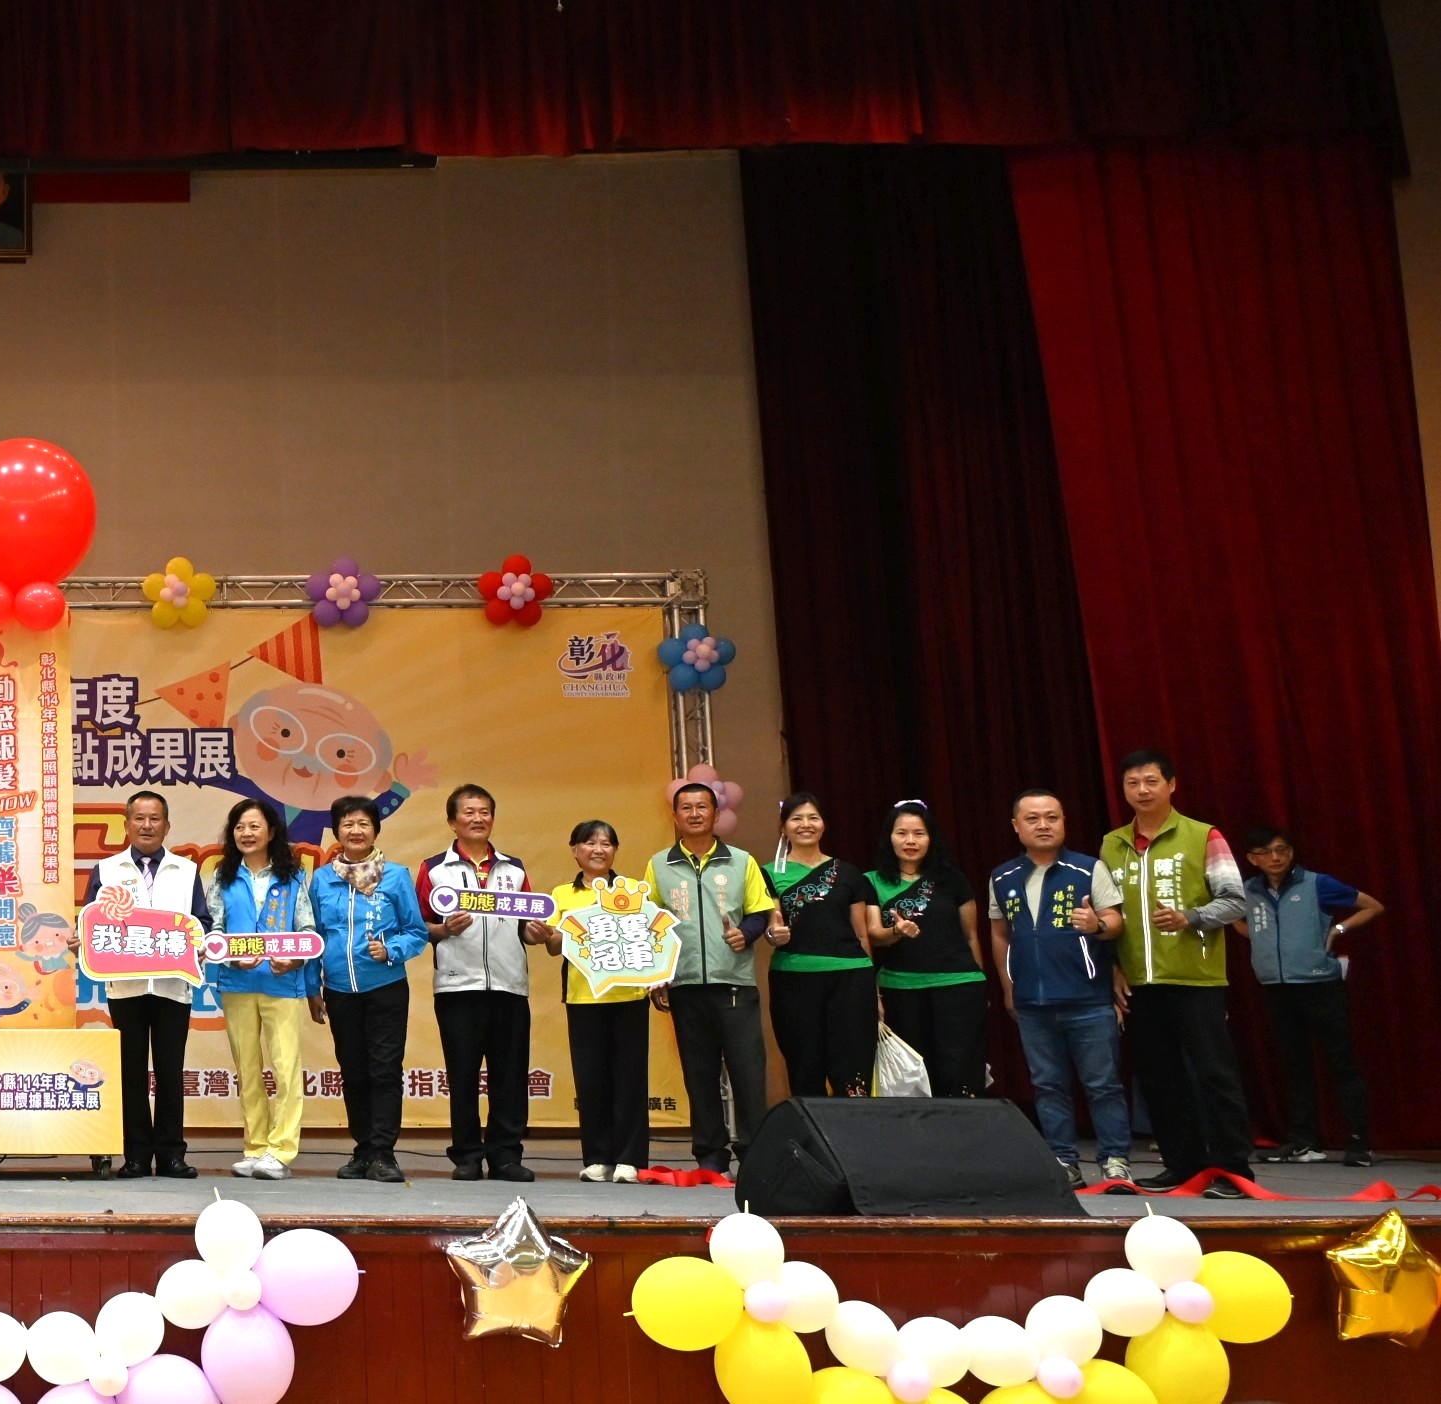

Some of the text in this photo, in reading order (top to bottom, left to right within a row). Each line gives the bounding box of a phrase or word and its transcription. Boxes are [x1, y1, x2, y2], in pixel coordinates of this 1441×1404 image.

[567, 634, 631, 671] 彰化
[563, 683, 628, 691] CHANGHUA
[39, 652, 60, 884] 彰化縣114年度社區照顧關懷據點成果展
[458, 891, 546, 914] 動態成果展
[91, 923, 189, 958] 我最棒
[587, 913, 651, 944] 勇奪
[228, 936, 313, 956] 靜態成果展
[589, 941, 655, 971] 冠軍
